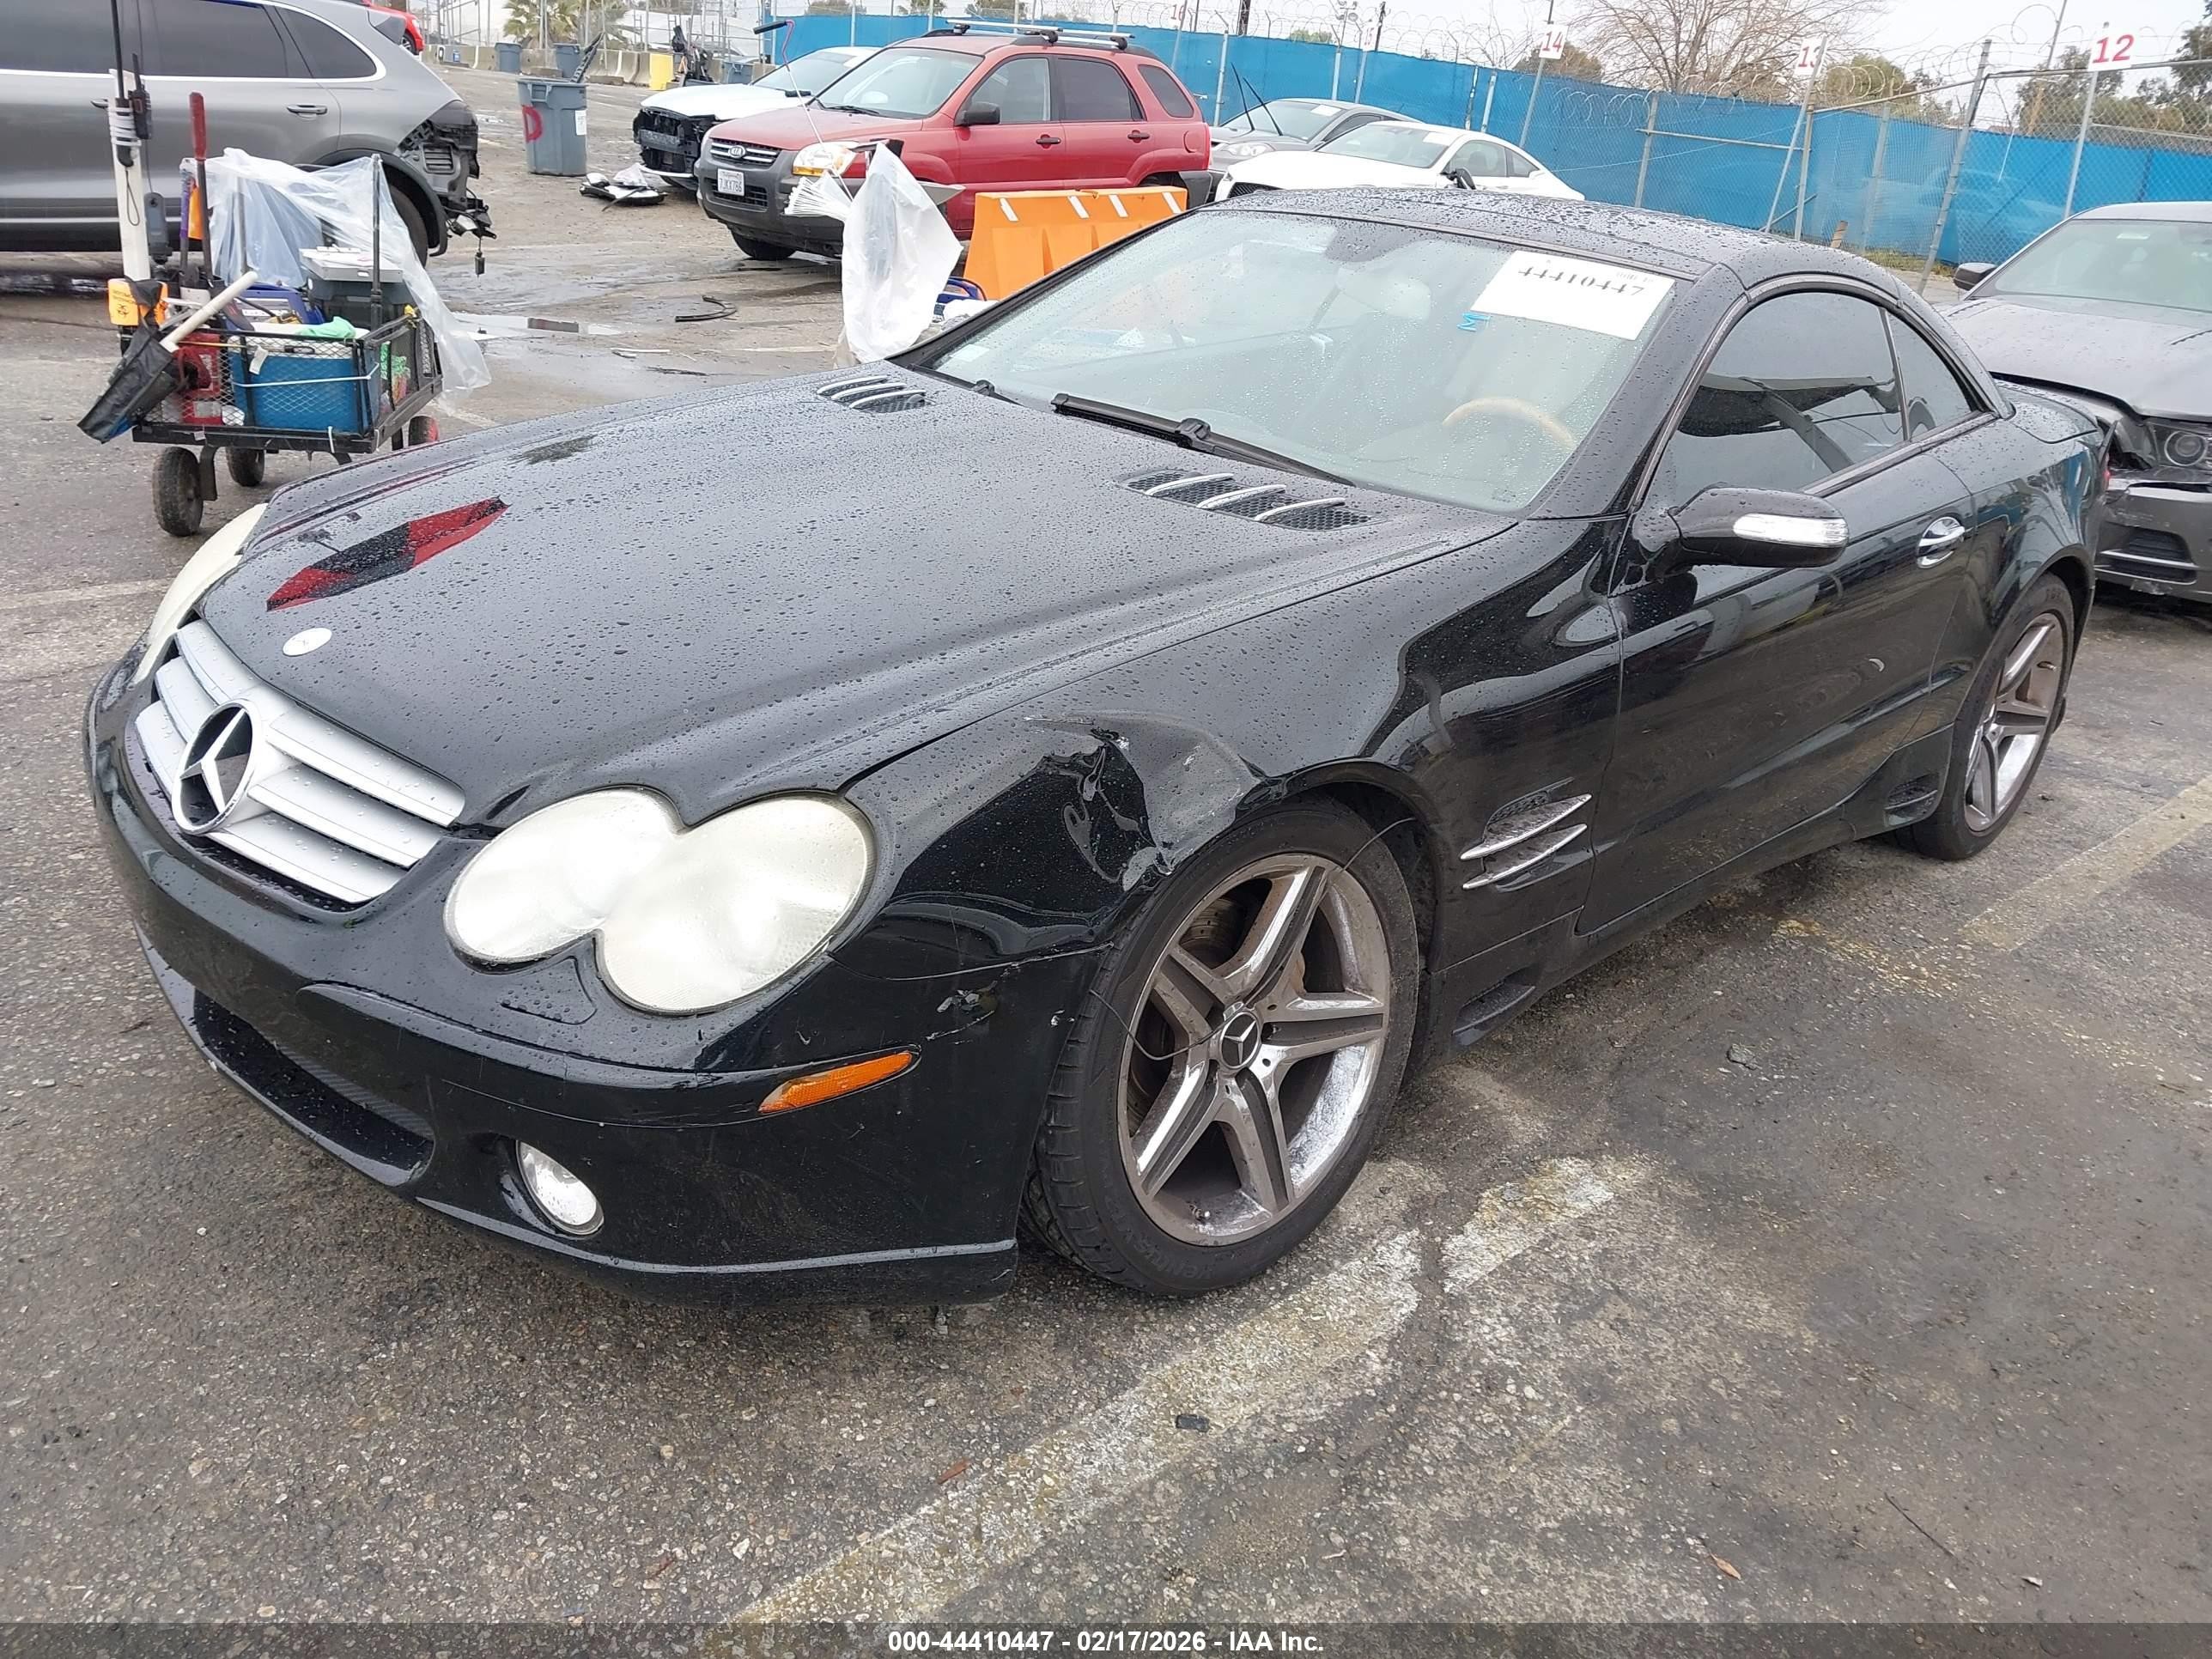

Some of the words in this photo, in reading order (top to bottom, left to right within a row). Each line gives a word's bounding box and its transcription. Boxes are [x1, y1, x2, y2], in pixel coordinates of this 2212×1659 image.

[1541, 30, 1564, 52] 14
[2092, 33, 2135, 64] 12
[521, 104, 543, 143] D
[1517, 266, 1645, 296] 44410447
